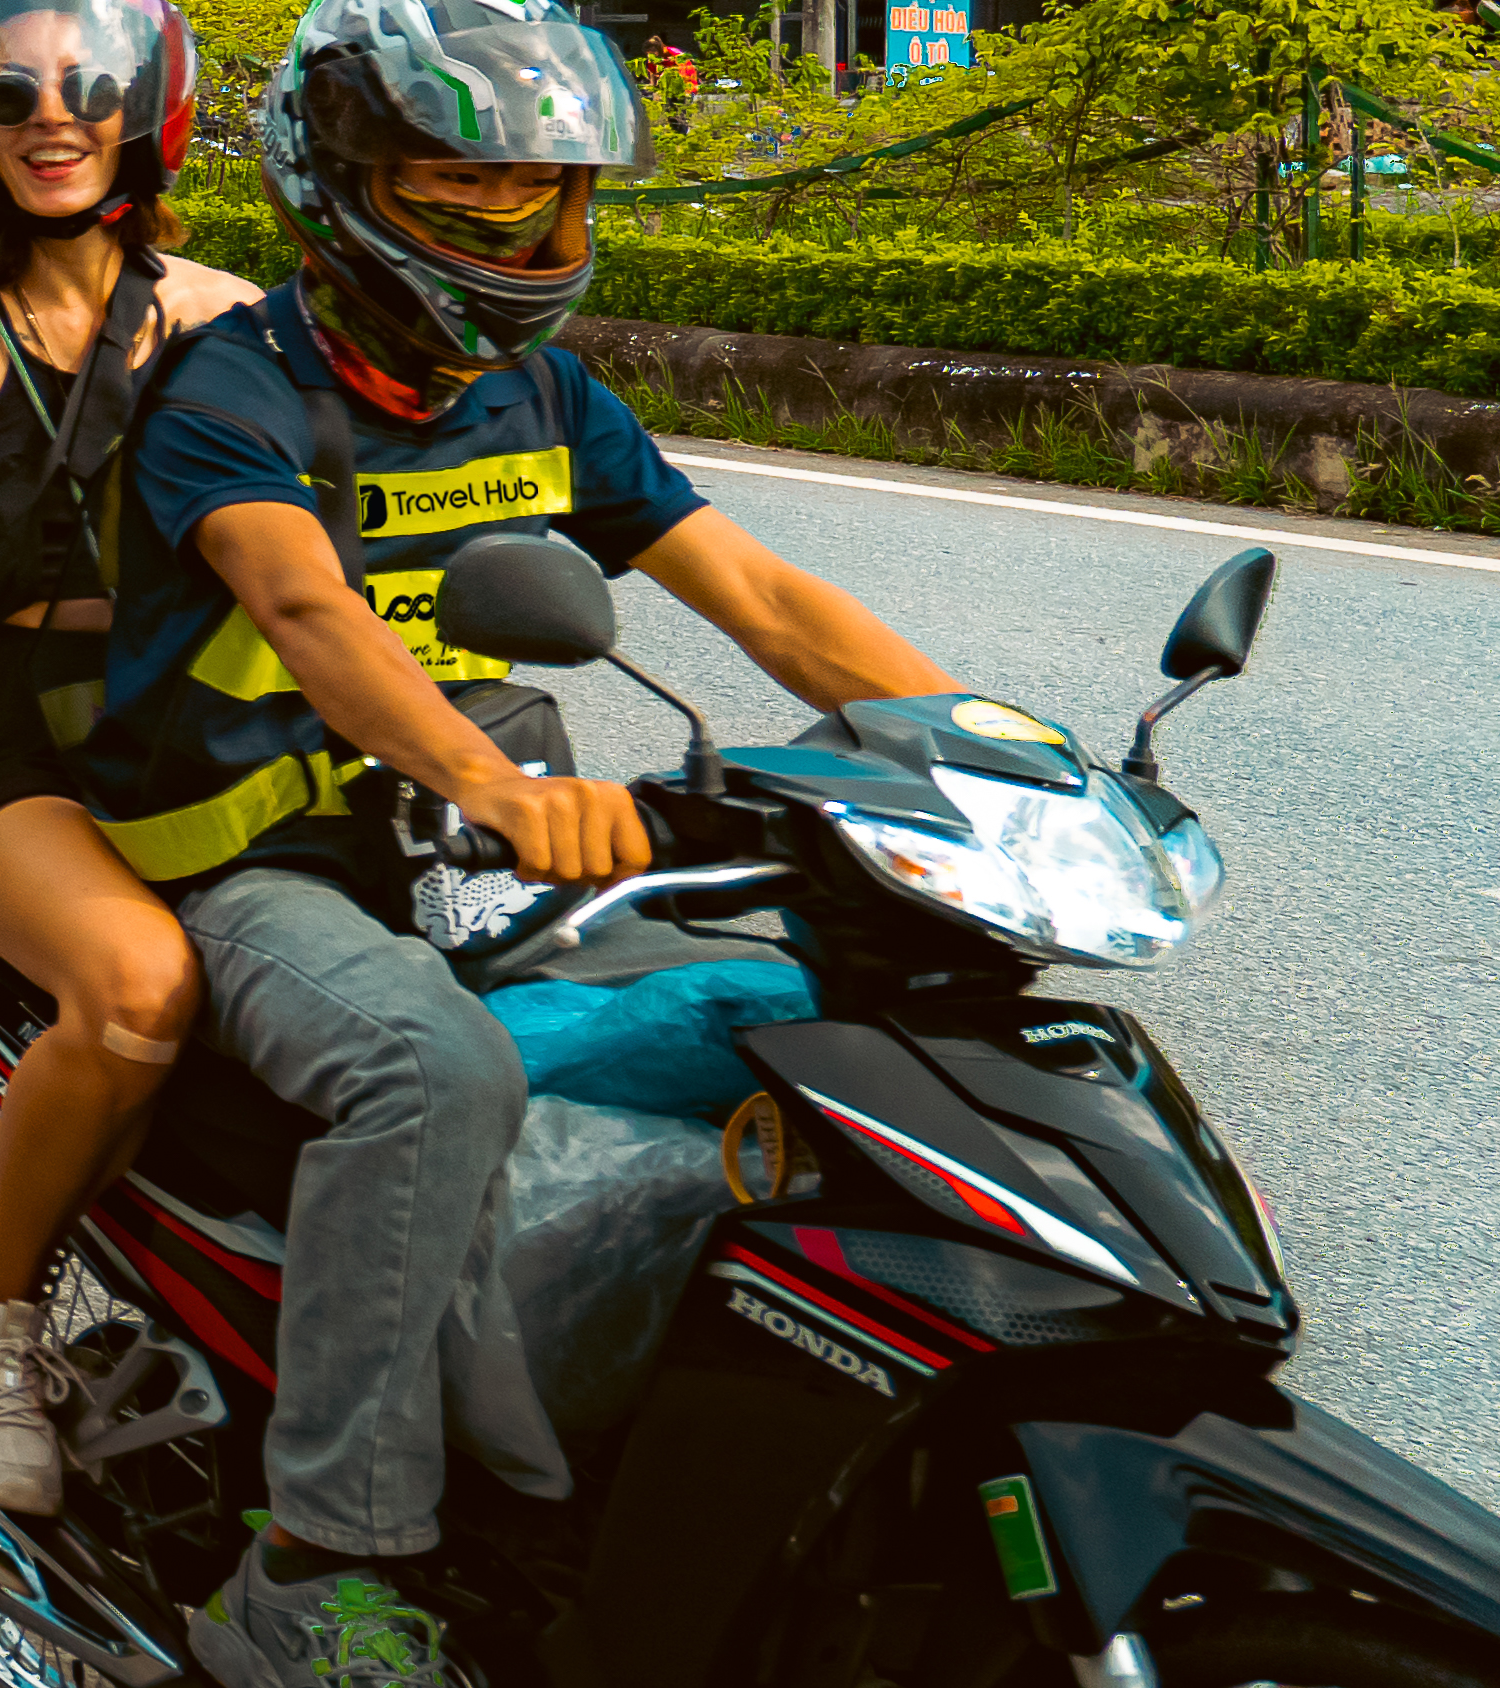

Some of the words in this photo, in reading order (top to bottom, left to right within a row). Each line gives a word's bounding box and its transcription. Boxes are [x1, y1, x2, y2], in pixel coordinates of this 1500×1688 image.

[932, 3, 968, 34] HÒA
[391, 483, 481, 516] Travel
[484, 476, 539, 505] Hub
[366, 584, 435, 623] Loo
[1020, 1020, 1117, 1044] HONDA
[725, 1286, 898, 1399] HONDA
